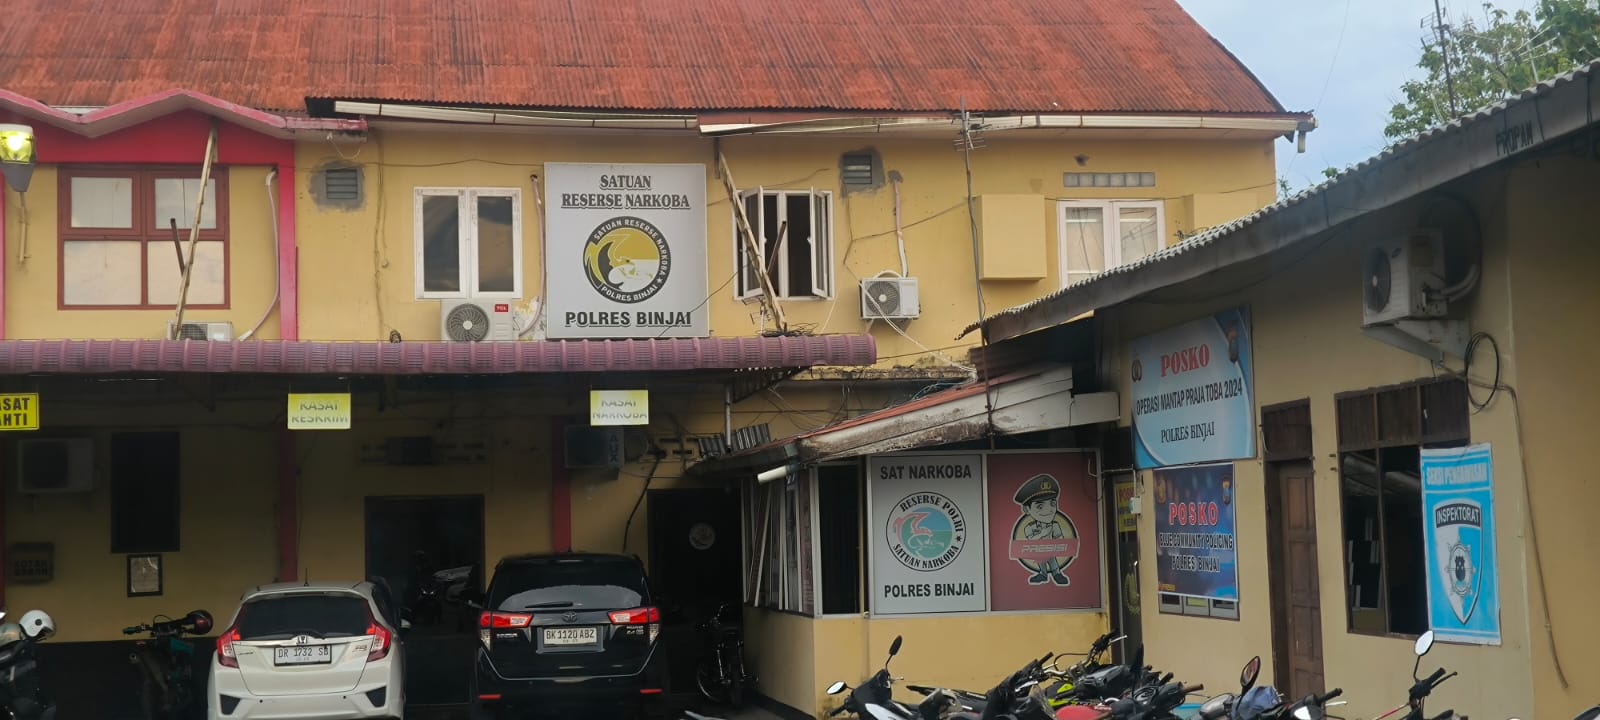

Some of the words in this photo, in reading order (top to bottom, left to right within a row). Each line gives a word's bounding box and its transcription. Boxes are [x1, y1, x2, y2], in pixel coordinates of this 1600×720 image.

[600, 174, 652, 188] SATUAN
[561, 193, 623, 208] RESERSE
[625, 193, 691, 208] NARKOBA
[593, 219, 623, 241] SATUAN
[624, 219, 659, 239] RESERSE
[657, 237, 669, 277] NARKOBA
[600, 285, 633, 302] POLRES
[633, 284, 659, 302] BINJAI
[565, 311, 631, 325] POLRES
[636, 311, 692, 325] BINJAI
[1160, 343, 1210, 378] POSKO
[0, 398, 30, 410] SAT
[1136, 394, 1160, 415] OPERASI
[1160, 391, 1185, 411] MANTAP
[1185, 386, 1205, 407] PRAJA
[1205, 382, 1223, 403] TOBA
[1224, 378, 1243, 399] 2024
[0, 413, 28, 426] HTI
[1160, 424, 1189, 443] POLRES
[1190, 421, 1215, 442] BINJAI
[880, 465, 905, 480] SAT
[908, 464, 972, 479] NARKOBA
[899, 494, 941, 513] RESERSE
[941, 502, 964, 533] POLRI
[1168, 501, 1219, 526] POSKO
[1436, 506, 1480, 524] INSPEKTORAT
[1173, 532, 1205, 549] COMMUNITY
[1205, 533, 1233, 551] POLICING
[892, 543, 920, 568] SATUAN
[922, 545, 960, 569] NARKOBA
[1171, 554, 1196, 571] POLRES
[1198, 555, 1221, 573] BINJAI
[884, 583, 931, 598] POLRES
[934, 582, 975, 597] BINJAI
[546, 630, 556, 639] BK
[557, 629, 578, 639] 1120
[579, 629, 595, 639] ABZ
[278, 648, 289, 658] DR
[294, 647, 313, 657] 1732
